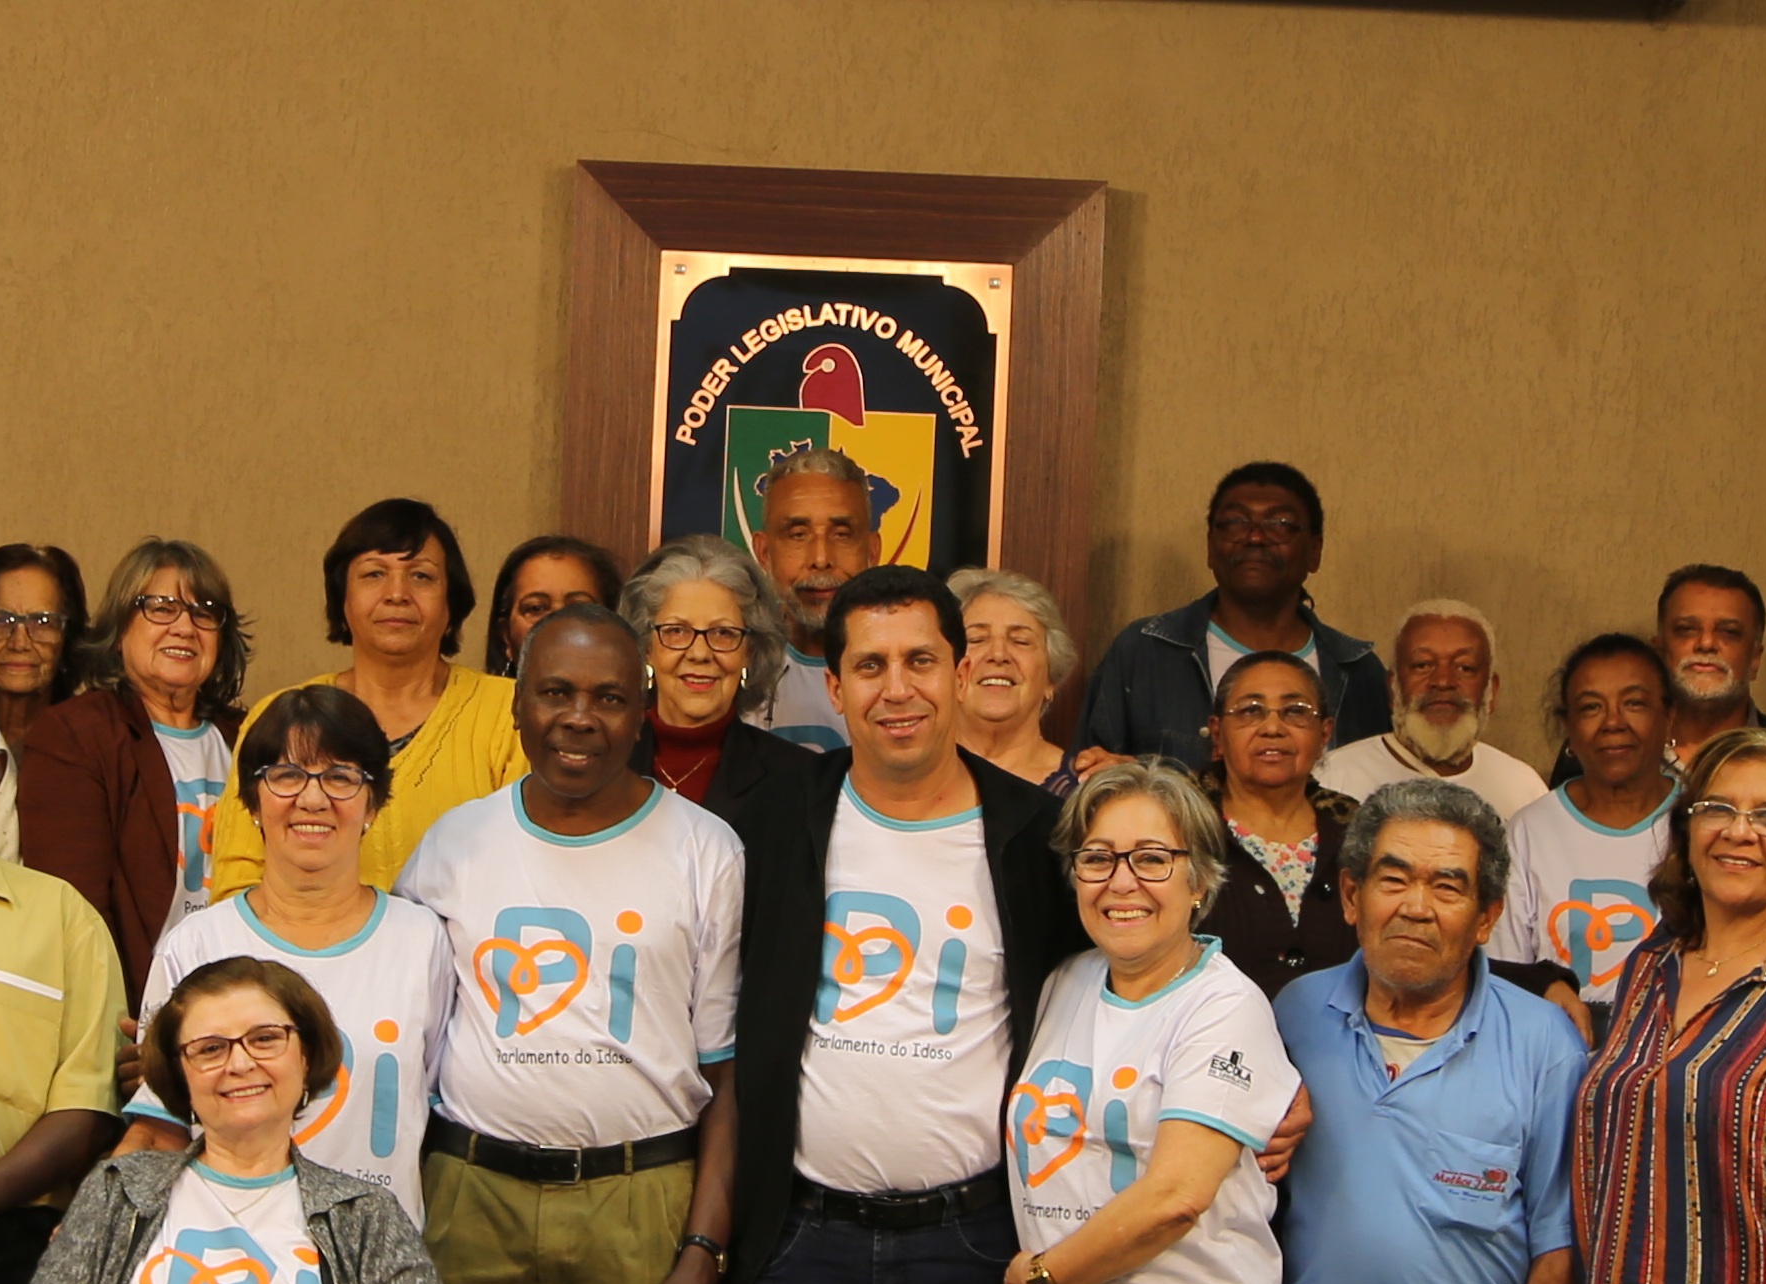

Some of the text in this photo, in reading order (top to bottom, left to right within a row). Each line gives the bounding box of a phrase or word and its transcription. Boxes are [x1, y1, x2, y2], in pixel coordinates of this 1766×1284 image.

[675, 302, 984, 459] PODER LEGISLATIVO MUNICIPAL
[574, 1048, 592, 1064] do
[596, 1049, 632, 1064] Idoso
[890, 1041, 907, 1057] do
[912, 1042, 953, 1060] Idoso
[1210, 1059, 1252, 1084] ESCOLA
[1075, 1205, 1091, 1220] do
